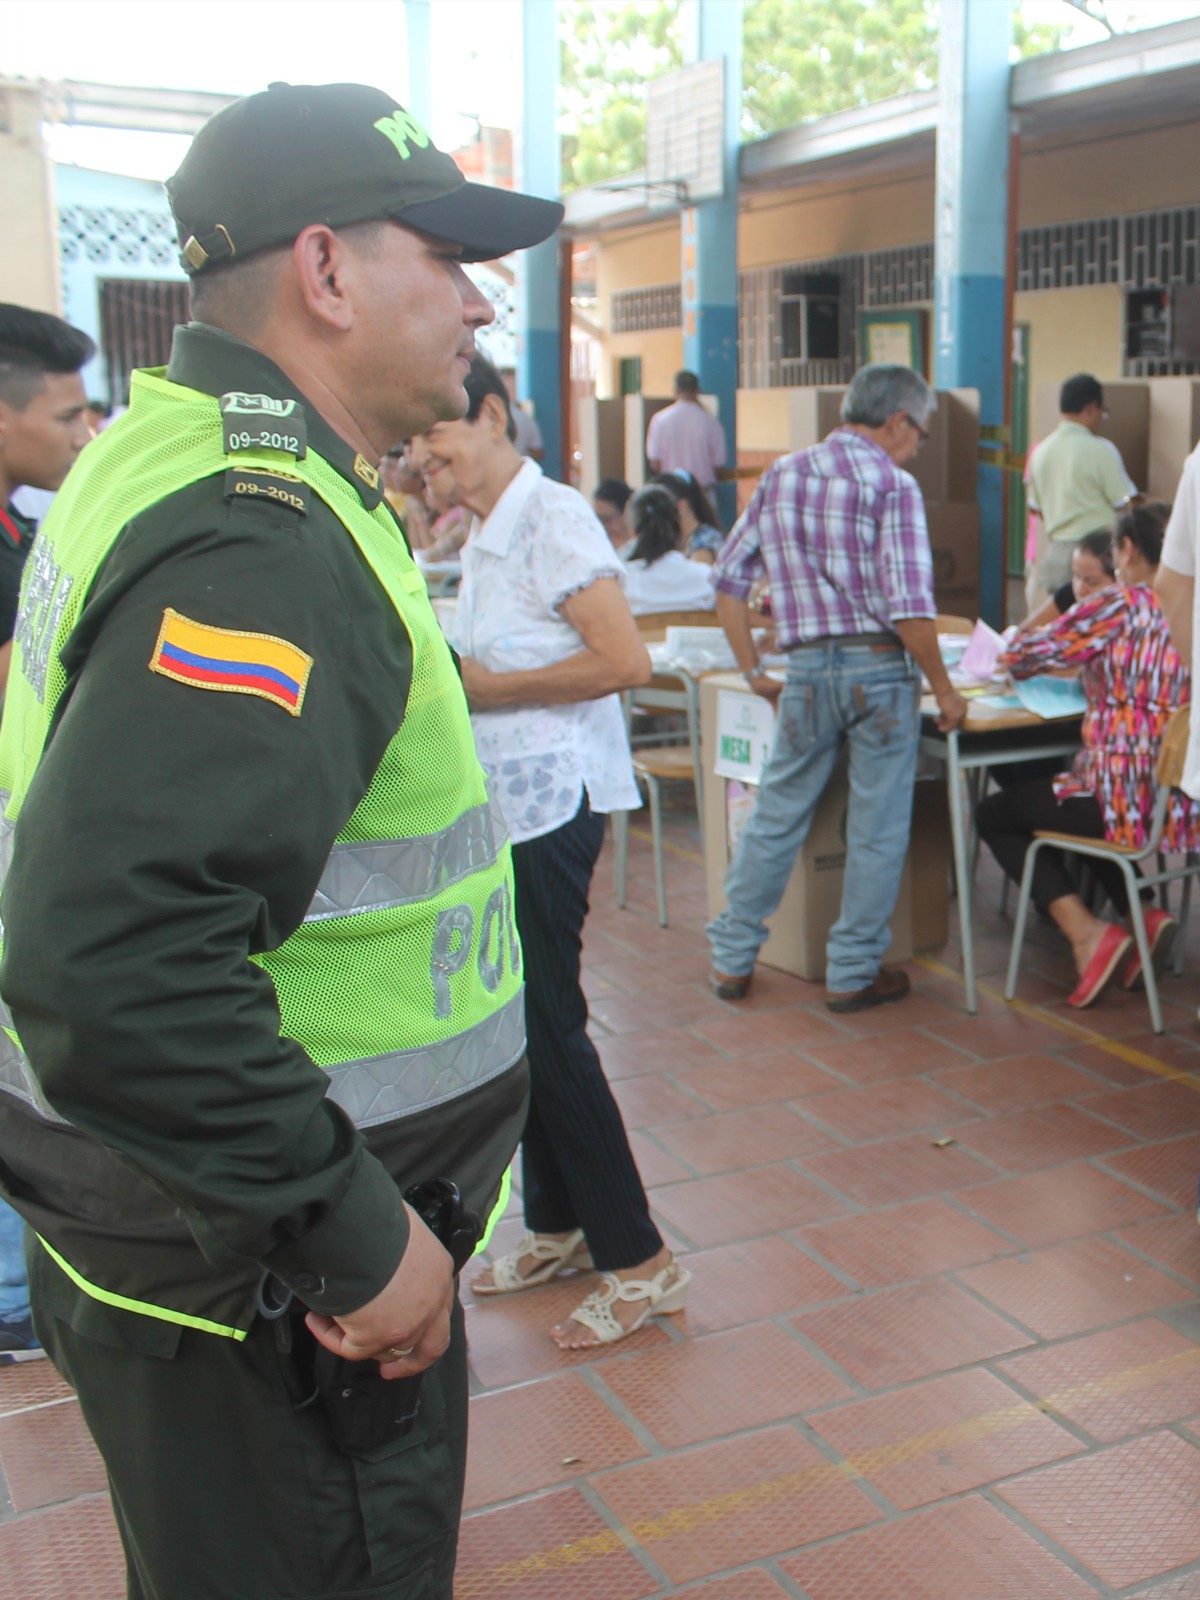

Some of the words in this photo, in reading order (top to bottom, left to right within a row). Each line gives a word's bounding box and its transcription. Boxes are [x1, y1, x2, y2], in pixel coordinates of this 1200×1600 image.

[229, 431, 299, 453] 09-2012
[235, 482, 306, 511] 09-2012
[720, 735, 752, 765] MESA
